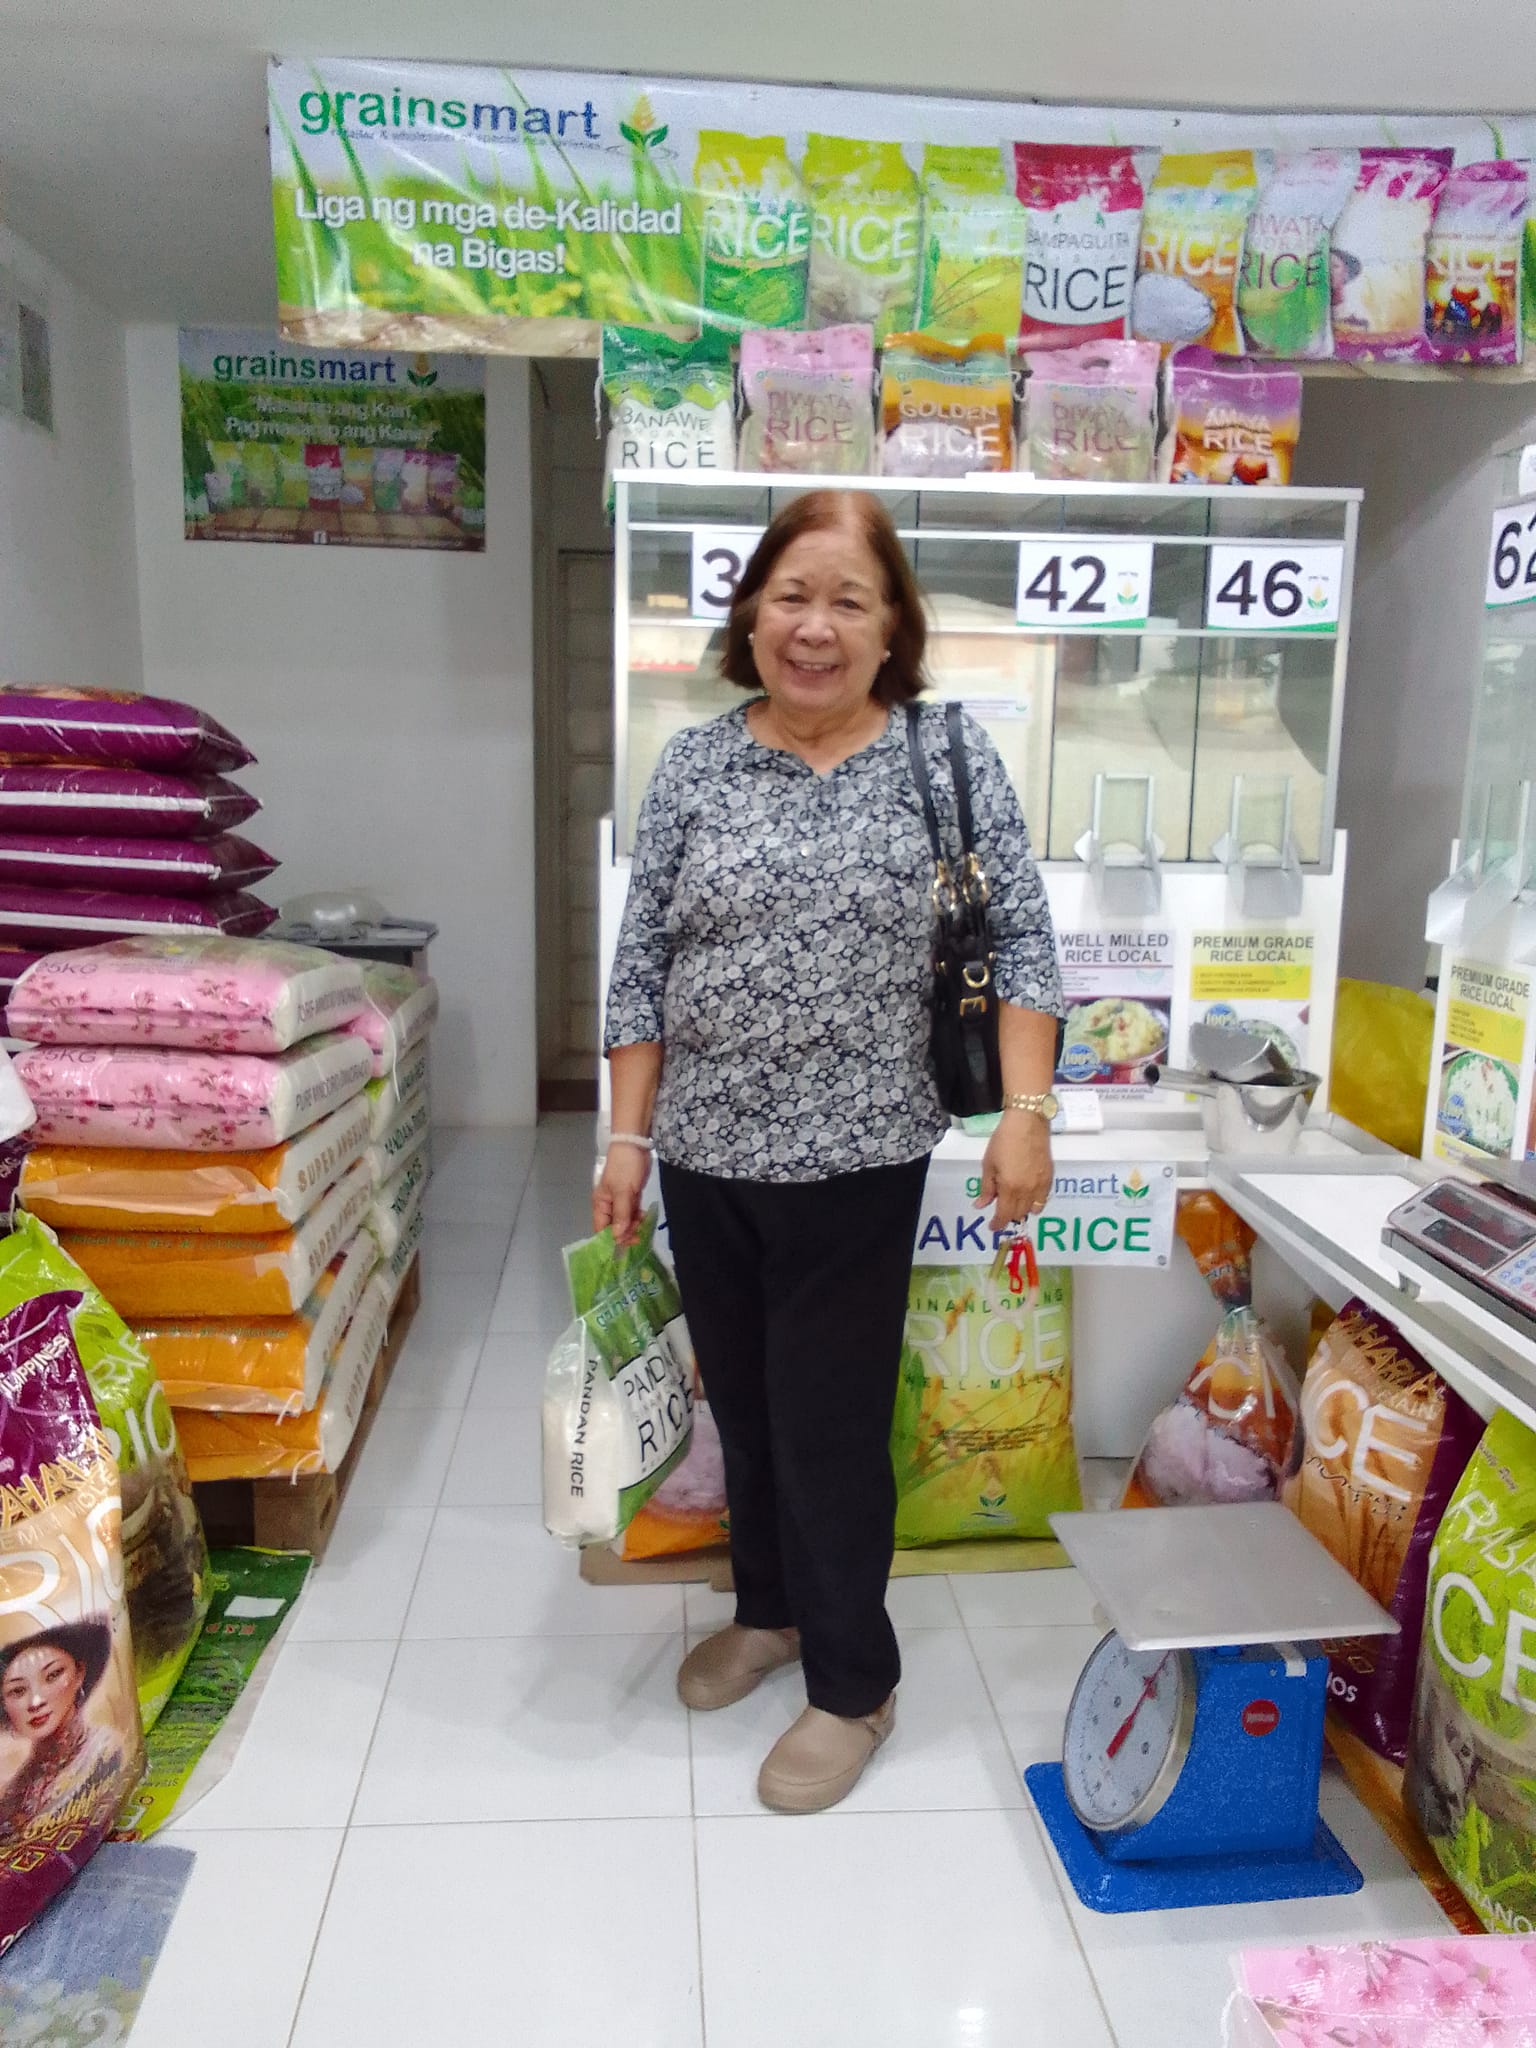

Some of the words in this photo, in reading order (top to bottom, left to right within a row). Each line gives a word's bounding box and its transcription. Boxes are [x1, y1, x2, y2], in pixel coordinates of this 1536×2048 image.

[300, 87, 600, 138] grainsmart
[296, 188, 365, 227] Liga
[372, 193, 414, 227] ng
[422, 198, 497, 235] mga
[504, 197, 681, 235] de-Kalidad
[704, 211, 809, 259] RICE
[811, 211, 919, 263] RICE
[1141, 227, 1235, 277] RICE
[412, 240, 455, 267] na
[461, 239, 565, 279] Bigas!
[1240, 251, 1323, 290] RICE
[1026, 261, 1128, 312] RICE
[213, 350, 396, 384] grainsmart
[622, 405, 711, 431] BANAWE
[901, 402, 998, 420] GOLDEN
[766, 415, 853, 444] RICE
[900, 424, 1002, 458] RICE
[1054, 428, 1139, 451] RICE
[1203, 428, 1273, 455] RICE
[622, 440, 716, 468] RICE
[1024, 555, 1107, 613] 42
[1216, 559, 1303, 617] 46
[1060, 933, 1104, 948] WELL
[1109, 933, 1168, 947] MILLED
[1065, 949, 1101, 963] RICE
[1108, 949, 1162, 963] LOCAL
[1193, 935, 1259, 949] PREMIUM
[1263, 936, 1314, 949] GRADE
[1210, 950, 1244, 962] RICE
[1247, 950, 1295, 962] LOCAL
[1451, 965, 1493, 988] PREMIUM
[1495, 976, 1530, 998] GRADE
[1460, 984, 1483, 1004] RICE
[1484, 990, 1516, 1012] LOCAL
[30, 1049, 98, 1064] 25KG
[298, 1146, 336, 1192] SUPER
[1038, 1216, 1151, 1251] RICE
[903, 1303, 1065, 1377] RICE
[575, 1359, 598, 1446] PANDAN
[638, 1373, 693, 1463] RICE
[570, 1451, 584, 1498] RICE
